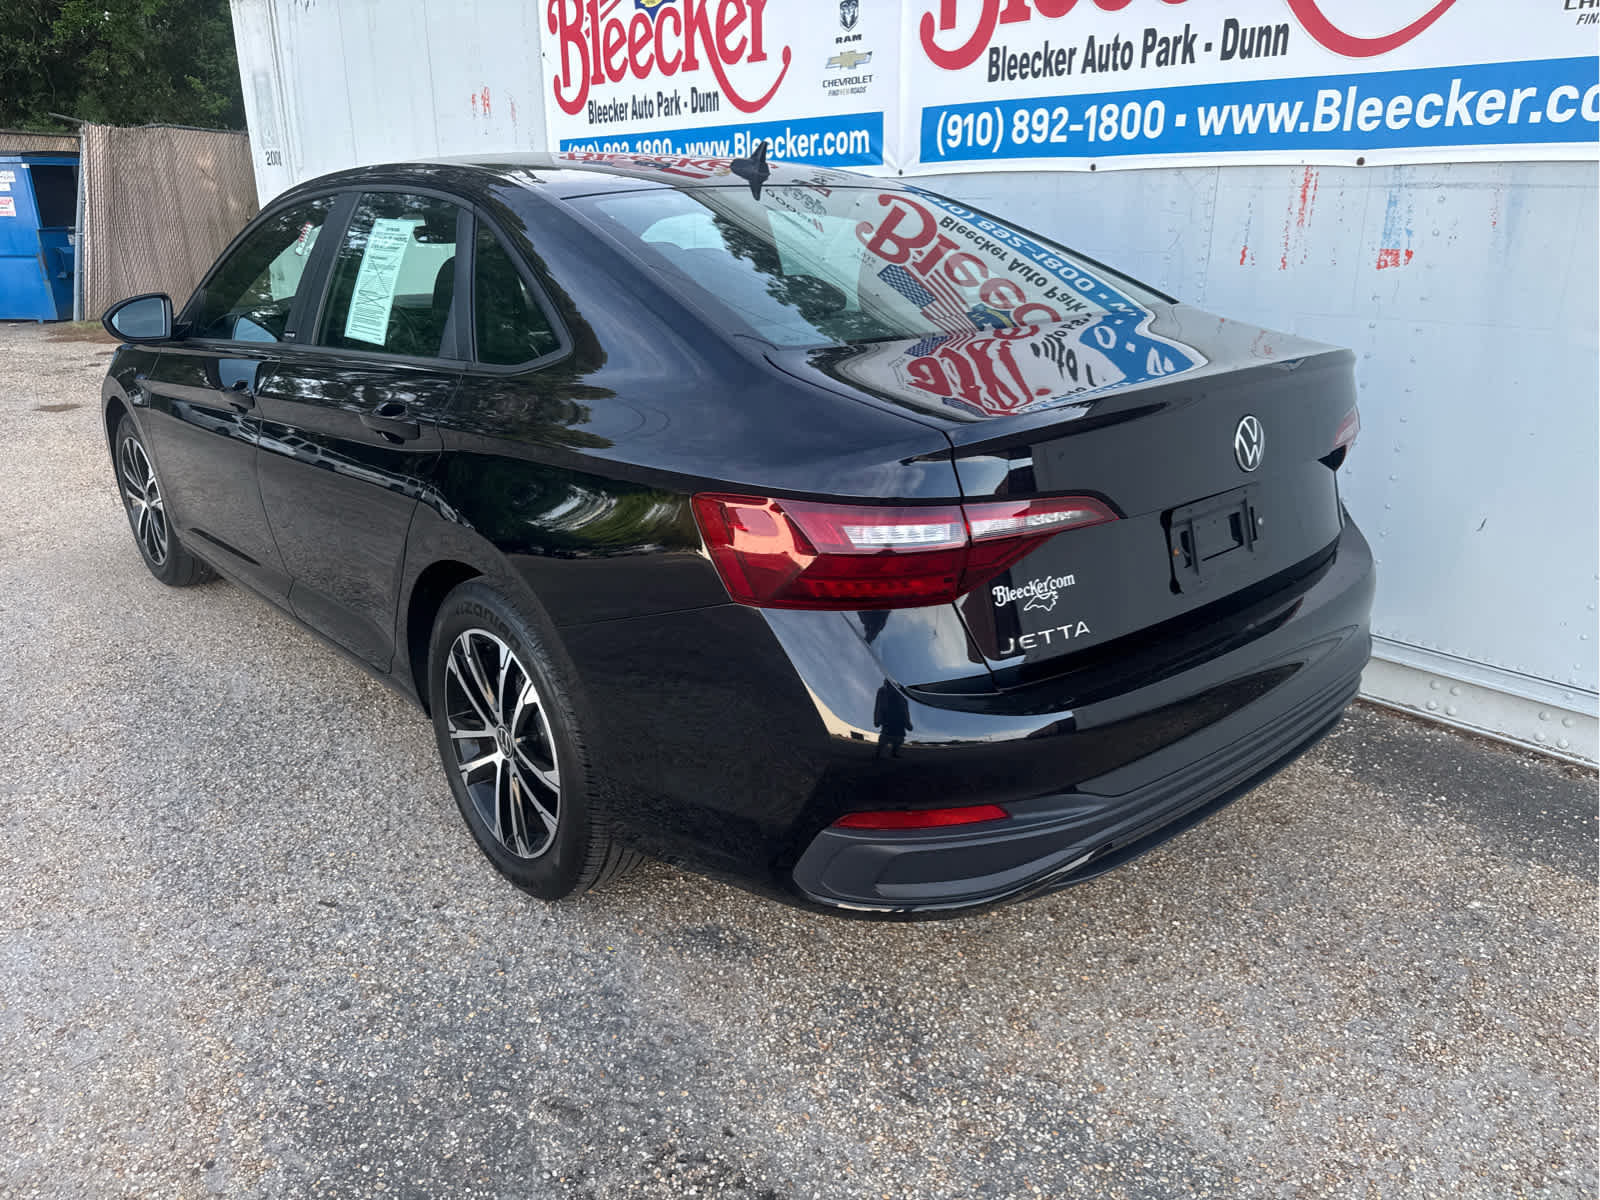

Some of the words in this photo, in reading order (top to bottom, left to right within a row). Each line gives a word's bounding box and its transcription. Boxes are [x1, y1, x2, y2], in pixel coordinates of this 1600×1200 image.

[1576, 12, 1599, 25] FIN
[835, 33, 863, 44] RAM
[987, 40, 1076, 83] Bleecker
[1081, 32, 1134, 75] Auto
[1140, 24, 1198, 69] Park
[1219, 18, 1290, 61] Dunn
[547, 0, 792, 115] Bleecker
[822, 74, 873, 88] CHEVROLET
[588, 99, 629, 124] Bleecker
[631, 93, 654, 120] Auto
[657, 88, 682, 116] Park
[691, 86, 720, 113] Dunn
[936, 106, 1004, 155] (910)
[1012, 99, 1166, 145] 892-1800
[992, 574, 1076, 607] Bleecker.com
[1000, 621, 1091, 655] JETTA
